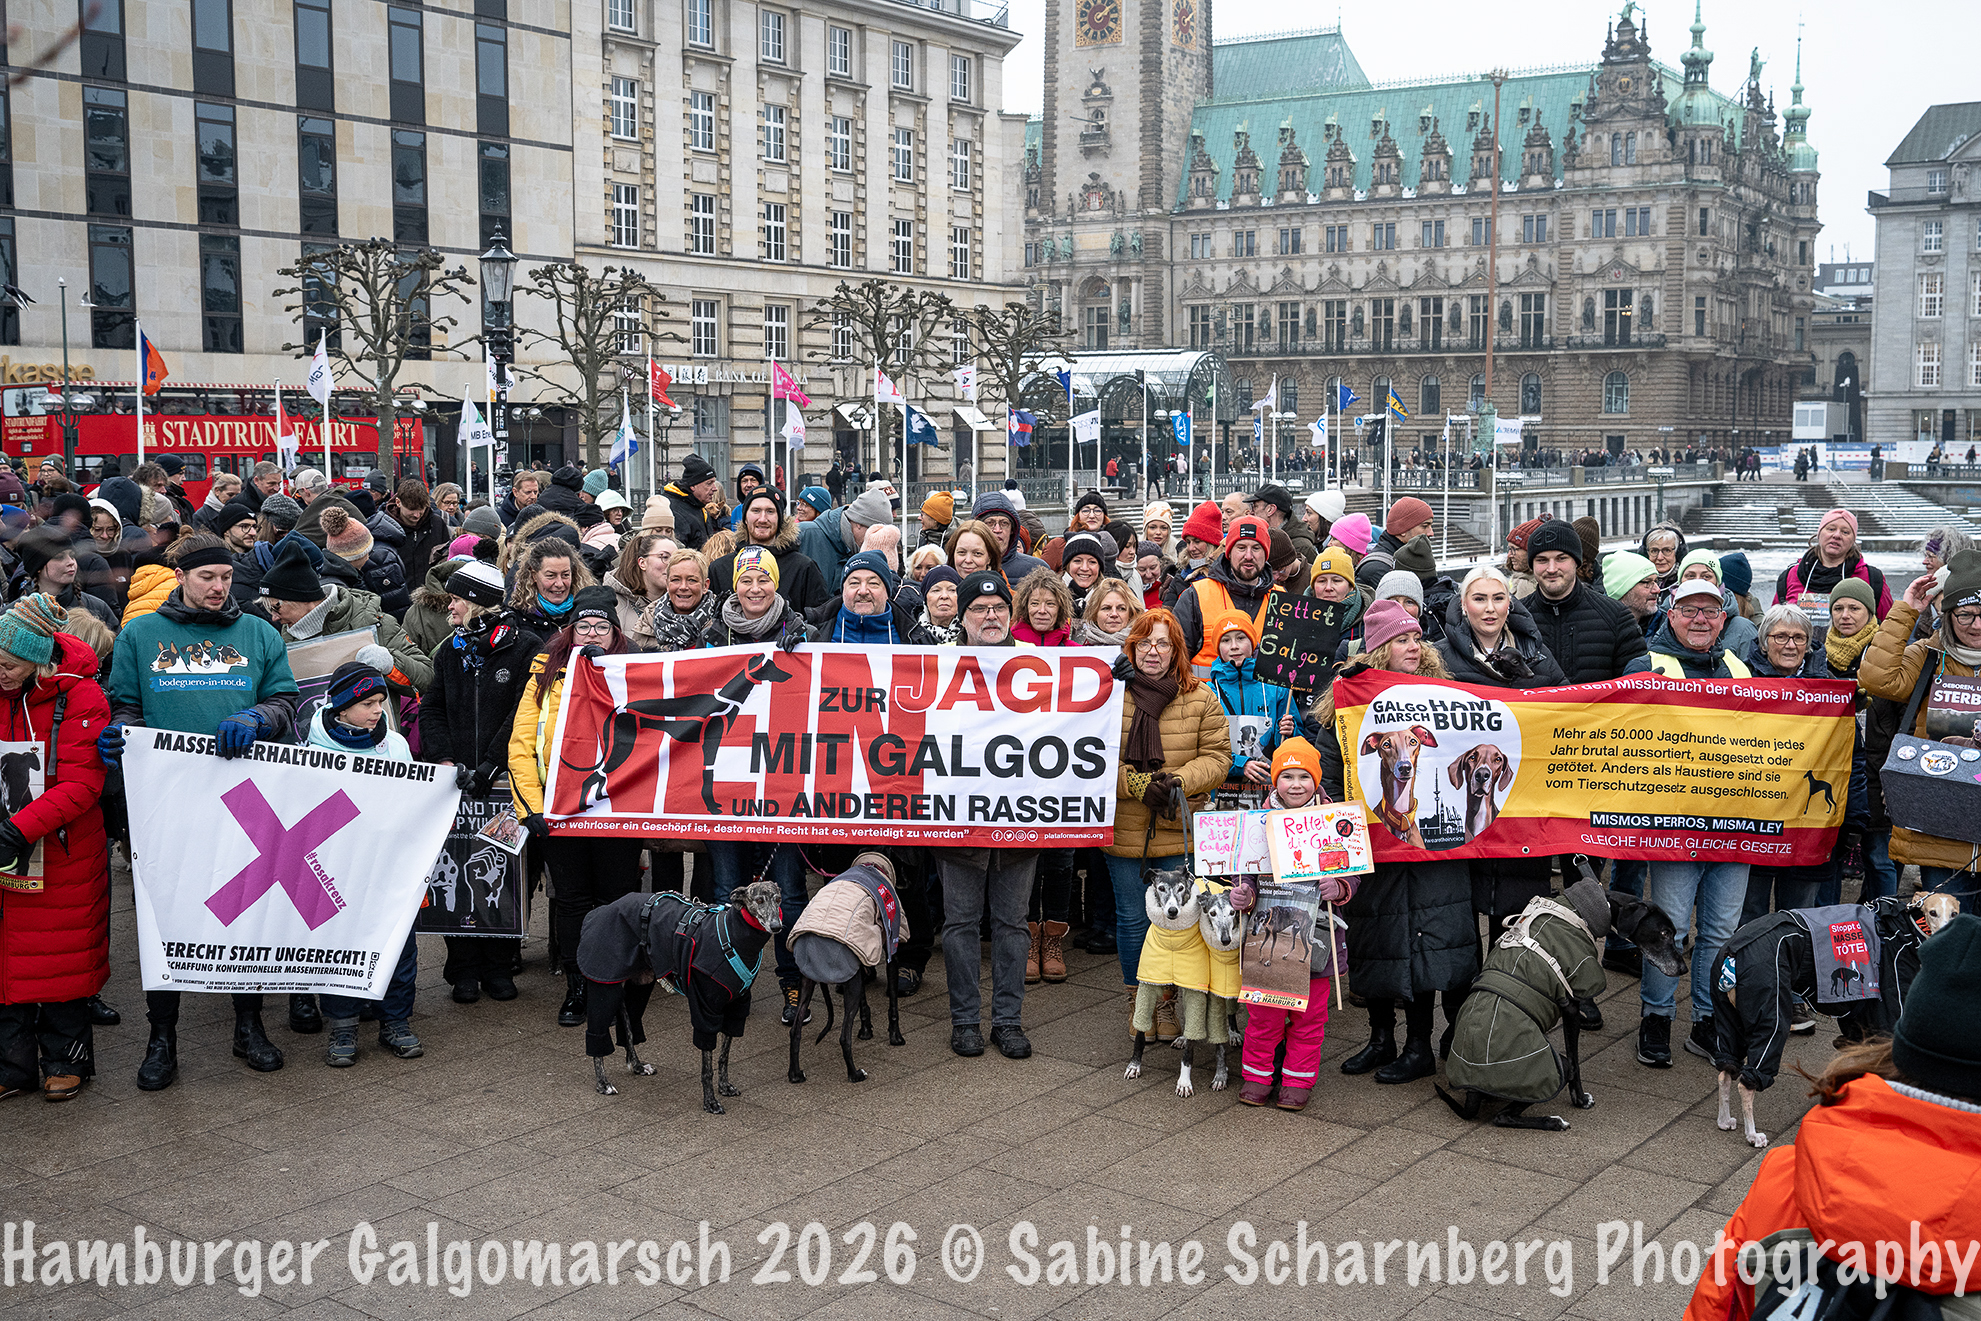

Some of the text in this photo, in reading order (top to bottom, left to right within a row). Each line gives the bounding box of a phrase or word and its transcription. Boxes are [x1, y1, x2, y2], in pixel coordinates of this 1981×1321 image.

[0, 354, 96, 384] kasse
[716, 370, 747, 384] BANK
[752, 370, 768, 383] OF
[162, 420, 360, 448] STADTRUNFAHRT
[1267, 592, 1335, 627] Rettet
[1267, 616, 1284, 631] die
[1260, 634, 1328, 668] Galgos
[159, 677, 246, 689] bodeguero-in-not.de
[819, 654, 1114, 714] ZUR JAGD
[1616, 677, 1701, 693] Missbrauch
[1705, 682, 1729, 695] der
[1732, 684, 1779, 701] Galgos
[1781, 688, 1793, 701] in
[1942, 682, 1976, 692] GEBOREN,
[1373, 699, 1492, 713] GALGO HAM
[1374, 711, 1503, 732] MARSCH BURG
[1553, 727, 1805, 752] Mehr als 50.000 Jagdhunde werden jedes
[750, 732, 1107, 780] MIT GALGOS
[1550, 744, 1793, 767] Jahr brutal aussortiert, ausgesetzt oder
[352, 756, 436, 783] BEENDEN!
[1547, 761, 1781, 783] getötet. Anders als Haustiere sind sie
[1545, 778, 1789, 800] vom Tierschutzgesetz ausgeschlossen.
[732, 792, 1106, 823] UND ANDEREN RASSEN
[569, 820, 620, 830] wehrloser
[622, 821, 639, 831] ein
[641, 821, 691, 834] Geschöpf
[694, 822, 711, 834] ist,
[713, 822, 743, 833] desto
[745, 824, 774, 834] mehr
[777, 825, 809, 836] Recht
[811, 826, 830, 836] hat
[832, 827, 849, 838] es,
[851, 827, 904, 839] verteidigt
[906, 829, 920, 838] zu
[1199, 815, 1237, 829] Rettet
[1283, 815, 1329, 838] Rettet
[1592, 813, 1783, 834] MISMOS PERROS, MISMA LEY
[1044, 832, 1104, 841] plataformanac.org
[1207, 829, 1230, 841] die
[1580, 833, 1792, 854] GLEICHE HUNDE, GLEICHE GESETZE
[305, 851, 347, 910] #rosakreuz
[1831, 922, 1856, 933] Stoppt
[229, 945, 272, 962] STATT
[275, 947, 367, 966] UNGERECHT!
[215, 963, 282, 974] KONVENTIONELLER
[284, 965, 364, 978] MASSENTIERHALTUNG
[1262, 997, 1296, 1007] HAMBURG
